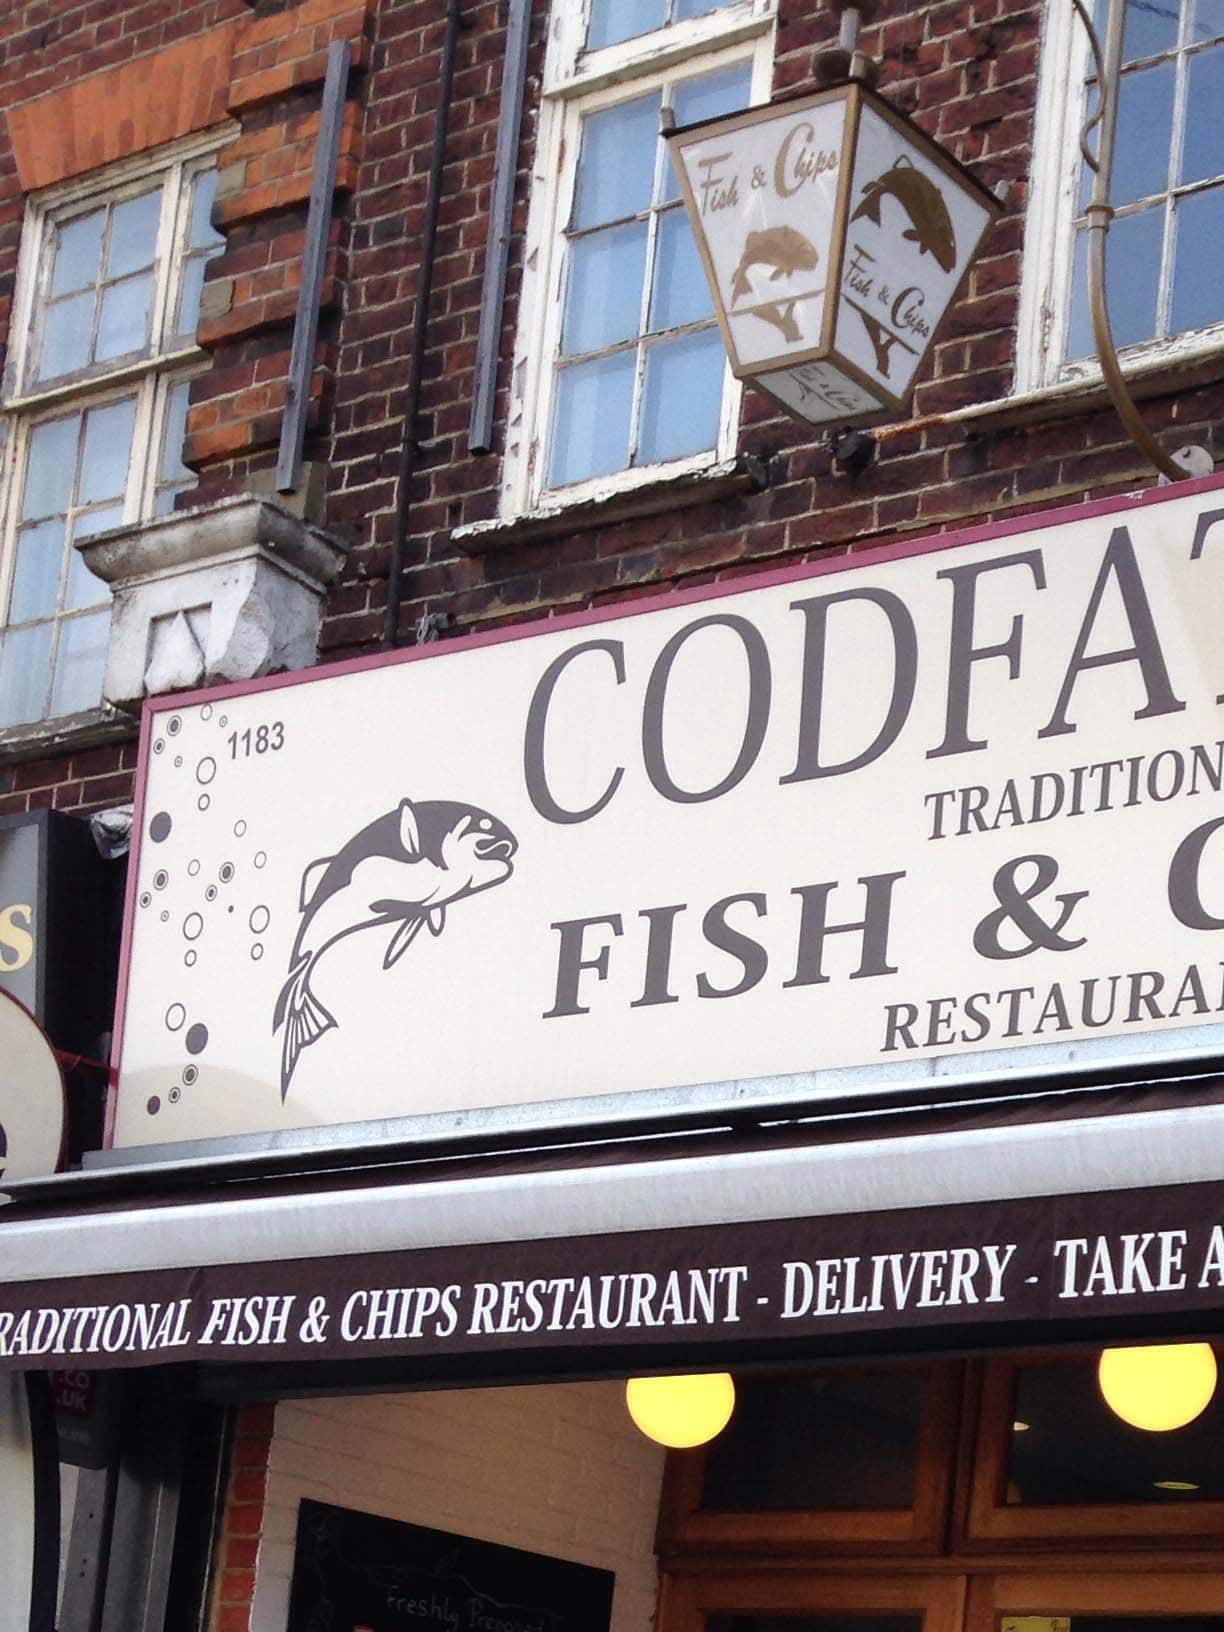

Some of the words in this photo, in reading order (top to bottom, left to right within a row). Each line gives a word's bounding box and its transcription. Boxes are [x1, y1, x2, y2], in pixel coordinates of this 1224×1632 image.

[697, 152, 739, 216] Fish
[751, 166, 768, 190] &
[774, 122, 839, 198] Chips
[842, 244, 876, 298] Fish
[877, 286, 890, 302] &
[891, 286, 931, 339] Chips
[226, 721, 286, 760] 1183
[543, 871, 906, 1018] FISH
[974, 855, 1089, 960] &
[198, 1296, 296, 1344] FISH
[299, 1296, 330, 1343] &
[340, 1284, 461, 1342] CHIPS
[467, 1266, 748, 1335] RESTAURANT
[780, 1245, 1017, 1318] DELIVERY
[1054, 1231, 1187, 1298] TAKE
